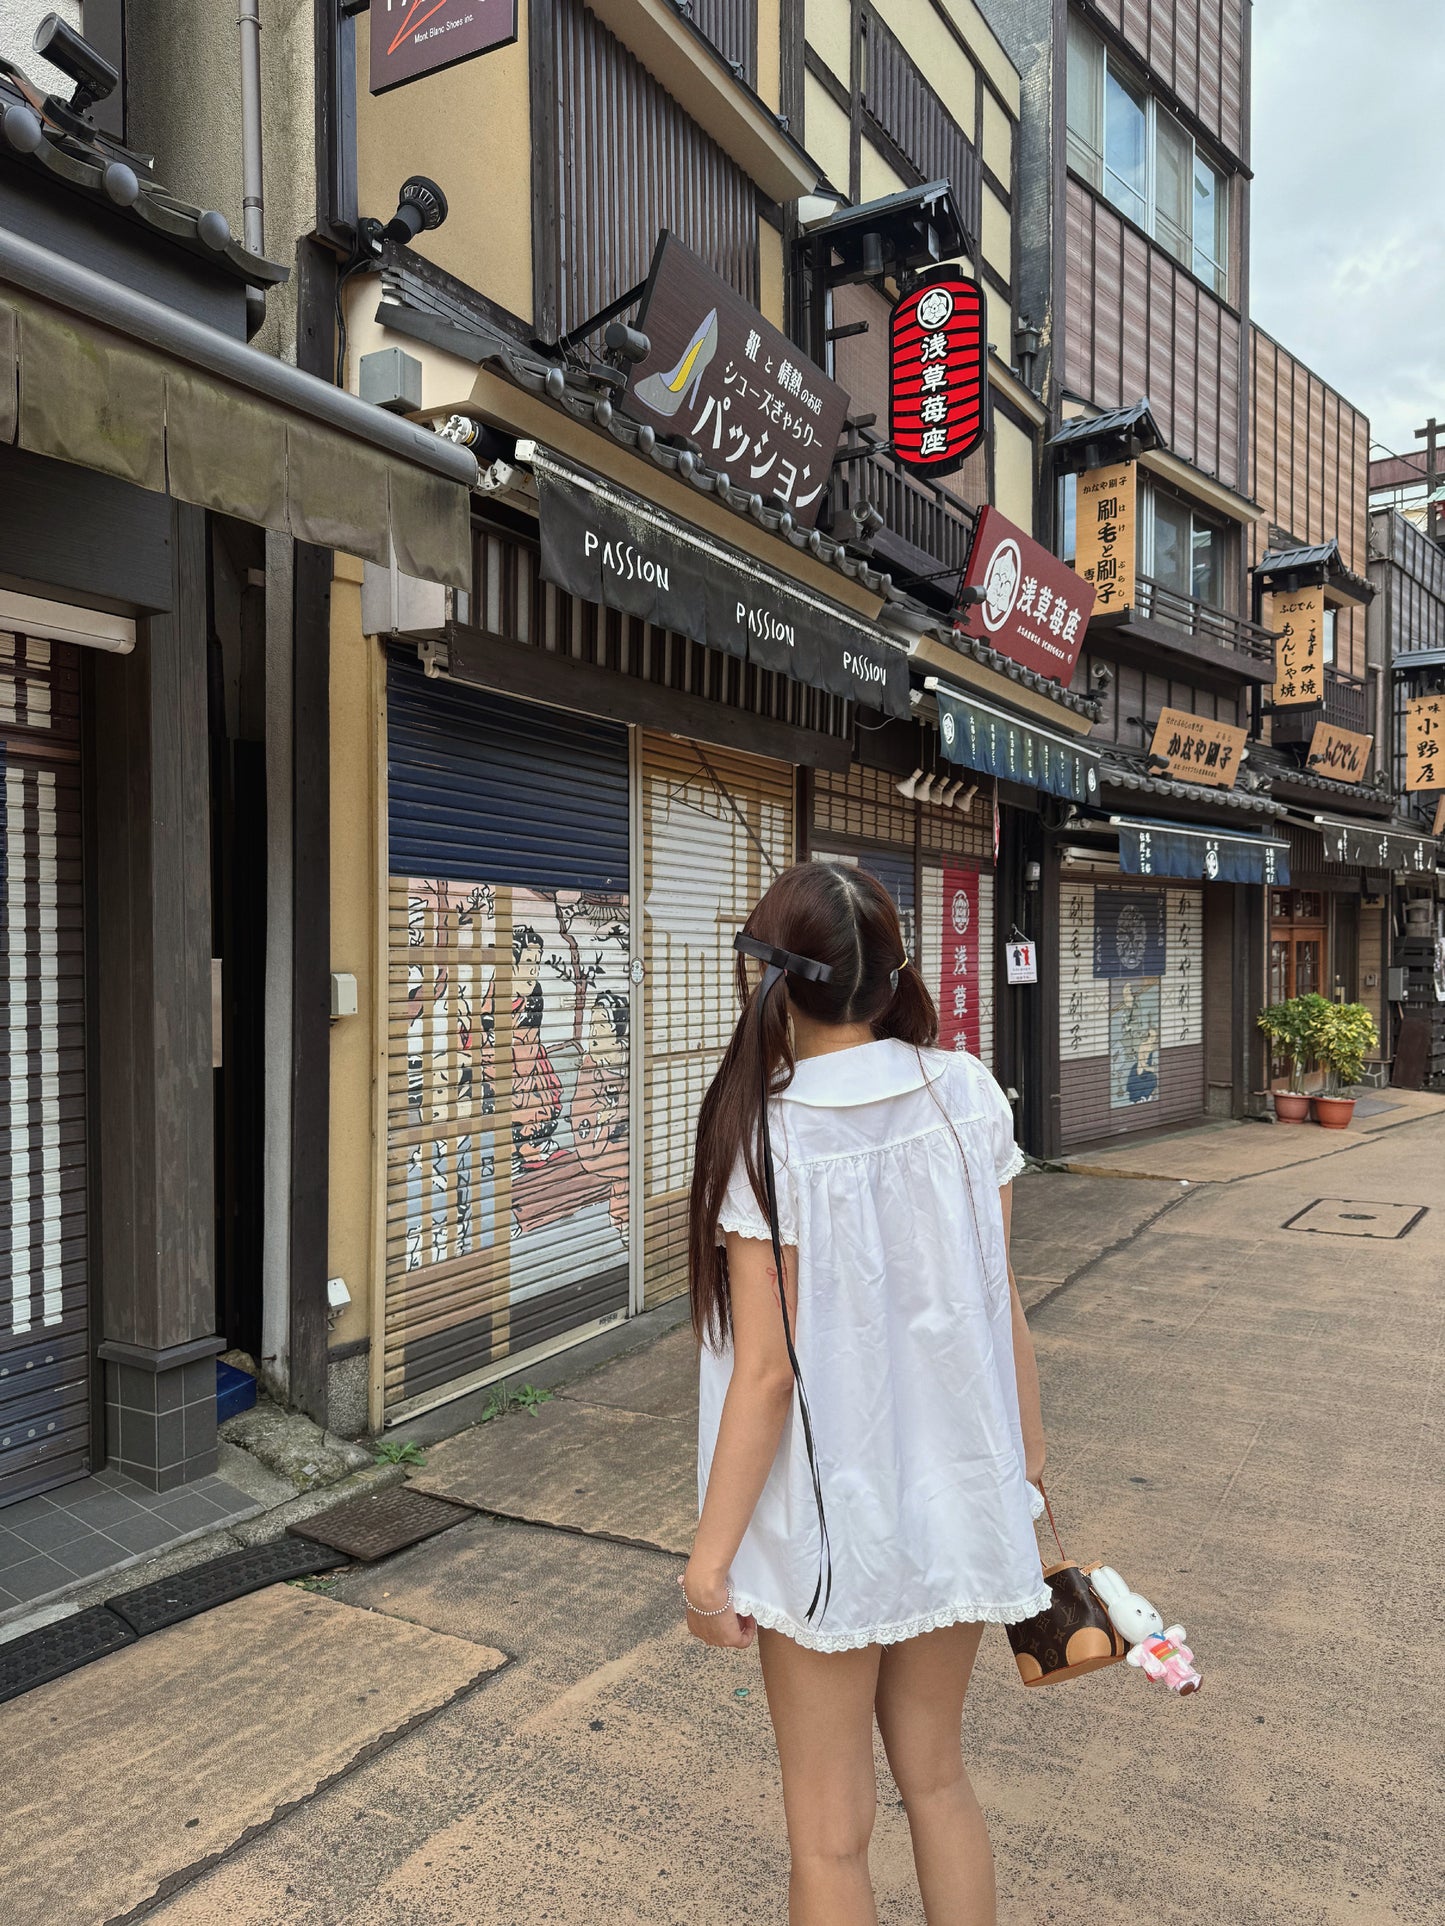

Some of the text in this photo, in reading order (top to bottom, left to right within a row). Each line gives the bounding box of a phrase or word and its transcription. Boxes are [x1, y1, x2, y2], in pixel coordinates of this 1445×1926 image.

[414, 32, 429, 44] Mont
[429, 25, 445, 38] Blanc
[446, 19, 463, 31] Shoes
[723, 360, 823, 448] シューズぎゃらりー
[920, 332, 948, 456] 浅草苺座
[691, 395, 823, 508] パッション
[1083, 476, 1127, 495] かなや刷子
[584, 530, 670, 591] PASSION
[1096, 497, 1117, 604] 刷毛と刷子
[736, 601, 795, 647] PASSION
[1016, 575, 1082, 645] 浅草苺座
[1017, 625, 1041, 646] ASAKUSA
[1281, 622, 1297, 697] もんじゃ焼
[1166, 732, 1233, 770] かなや刷子
[1416, 717, 1439, 783] 小野屋
